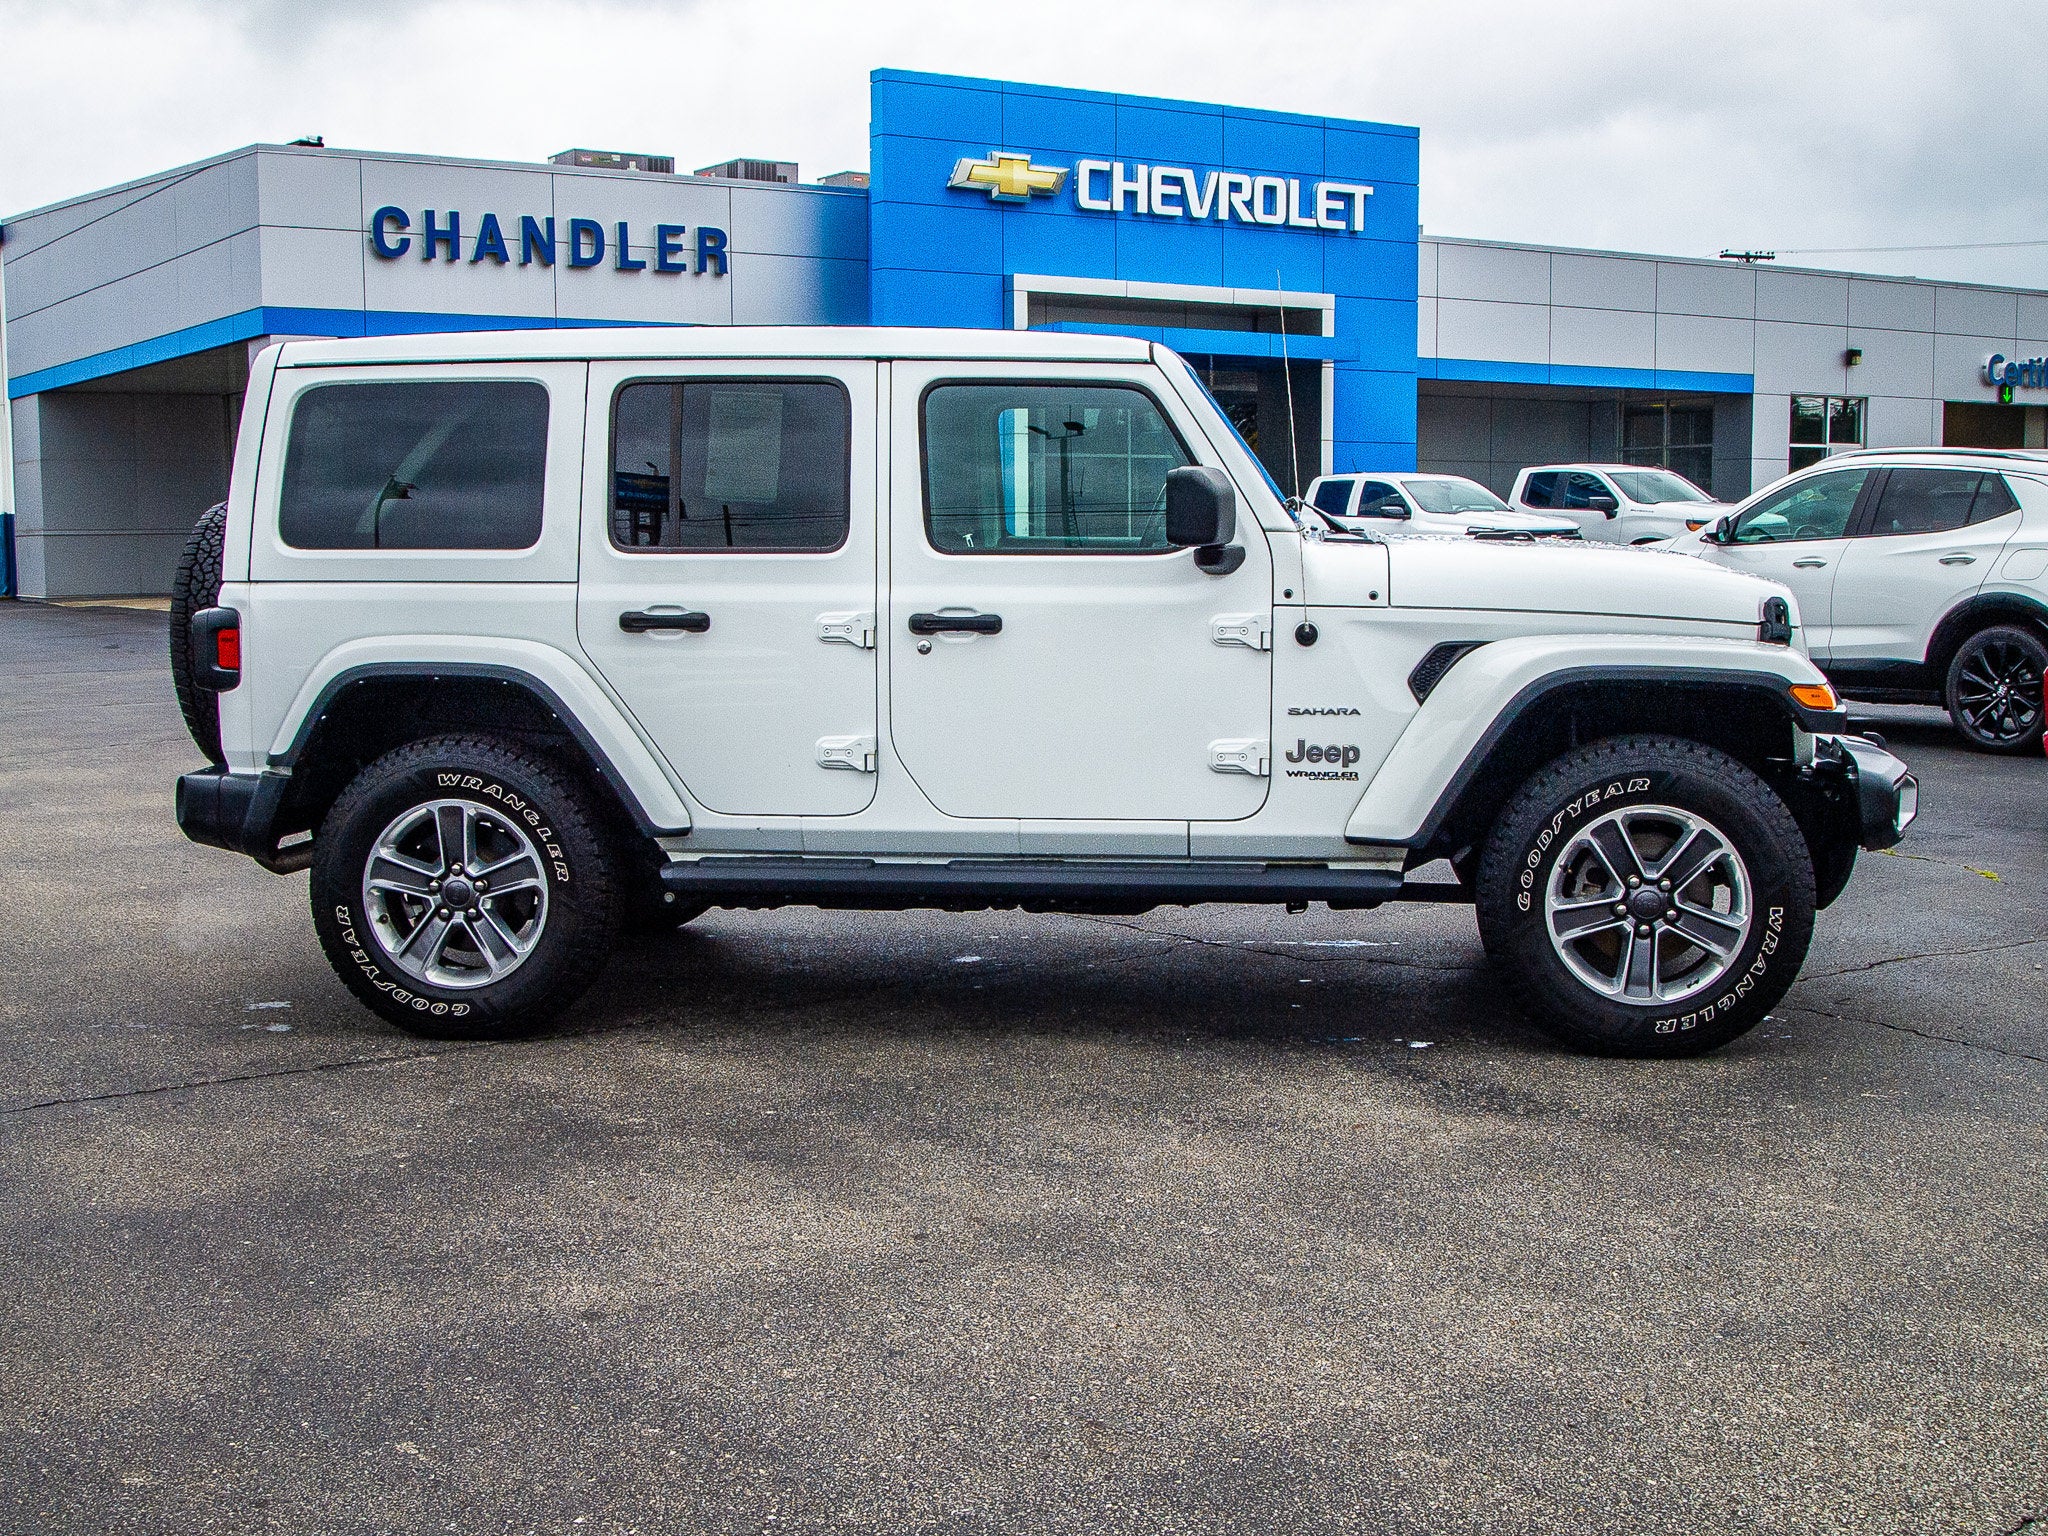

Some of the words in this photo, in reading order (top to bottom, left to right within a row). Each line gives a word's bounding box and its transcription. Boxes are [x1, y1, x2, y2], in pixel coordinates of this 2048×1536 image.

[1073, 159, 1374, 232] CHEVROLET
[369, 205, 730, 276] CHANDLER
[1287, 707, 1361, 716] SAHARA
[1286, 738, 1361, 768] Jeep
[1286, 770, 1359, 778] WRANGLER
[437, 773, 570, 883] WRANGLER
[1517, 777, 1651, 912] GOODYEAR
[336, 905, 471, 1017] GOODYEAR
[1655, 907, 1784, 1035] WRANGLER
